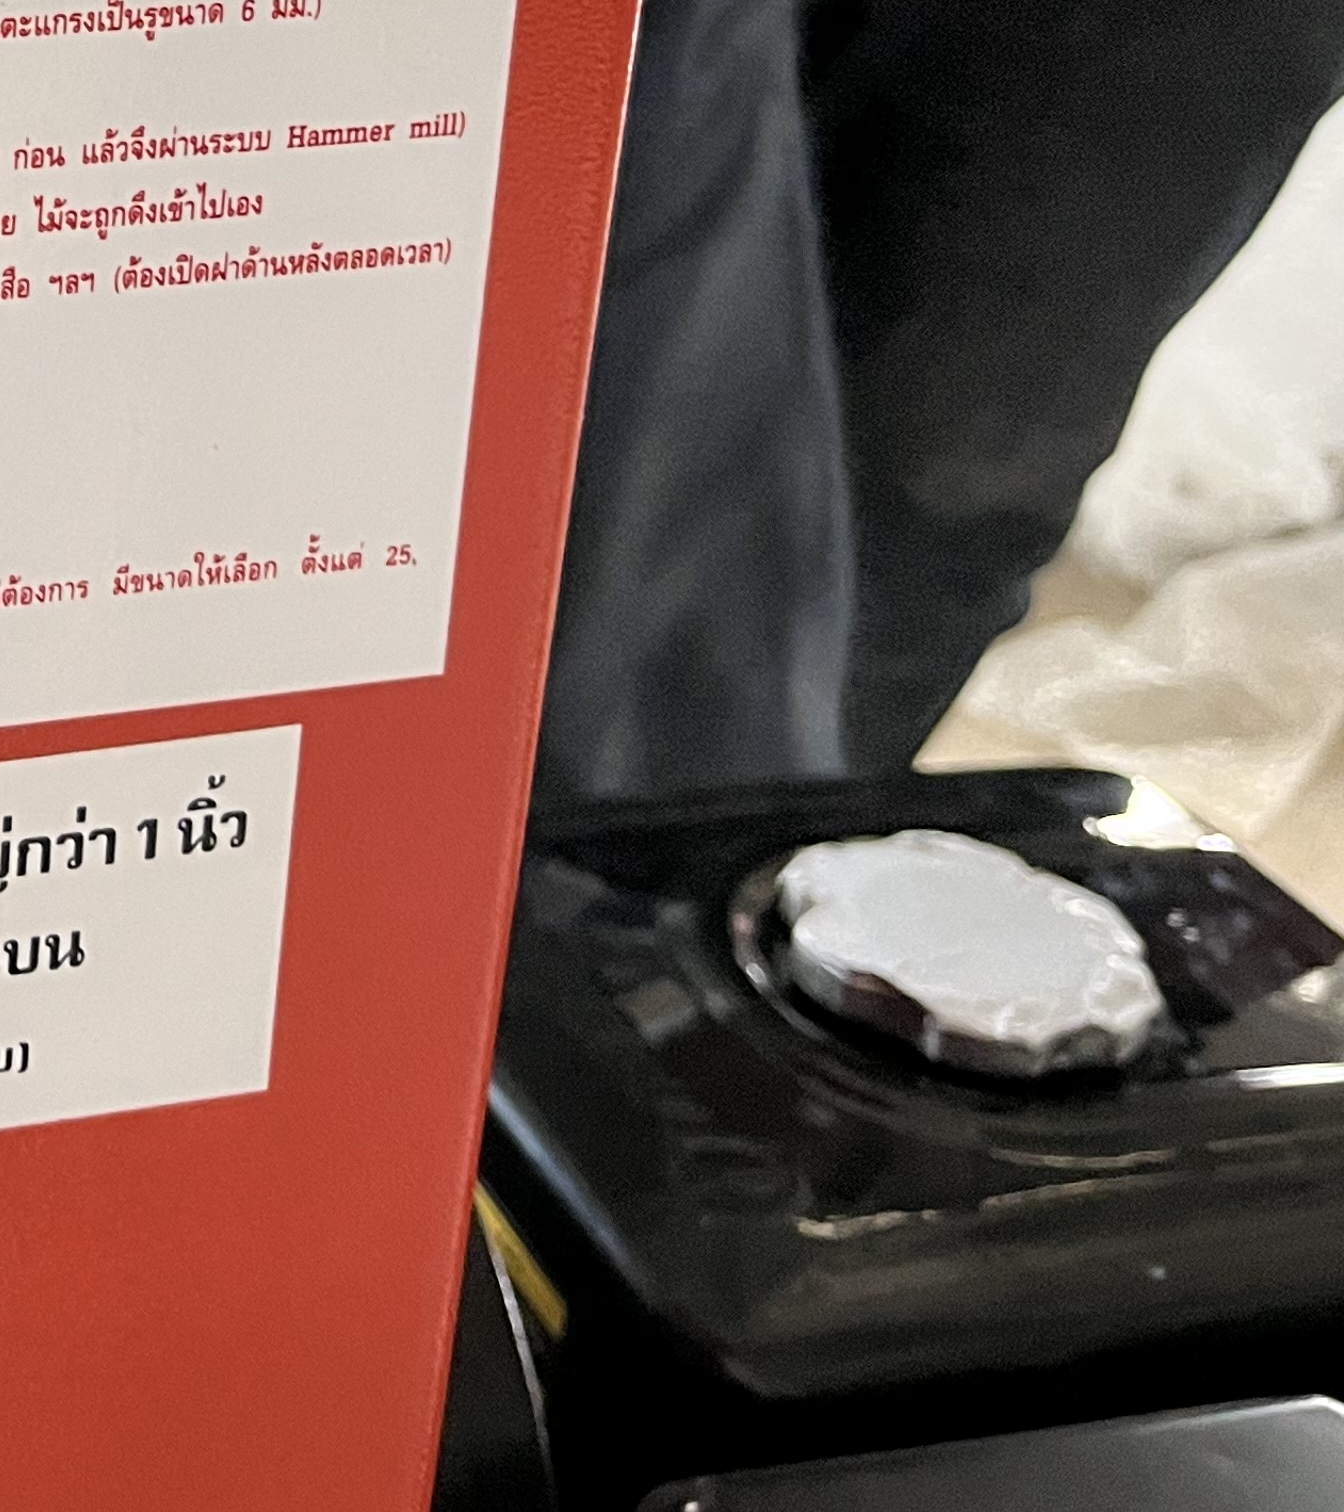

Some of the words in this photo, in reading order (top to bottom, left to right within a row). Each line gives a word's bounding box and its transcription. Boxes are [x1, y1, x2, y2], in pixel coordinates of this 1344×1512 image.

[12, 145, 66, 170] ก่อน
[80, 123, 272, 165] แล้วจึงผ่านระบบ
[286, 122, 395, 149] Hammer
[408, 112, 466, 140] mill)
[32, 181, 264, 241] ไม้จะถูกดึงเข้าไปเอง
[47, 271, 96, 295] ฯลฯ
[111, 550, 278, 596] มีขนาดให้เลือก
[300, 533, 363, 575] ตั้งแต่
[136, 817, 158, 860] 1
[176, 774, 247, 855] นิ้ว
